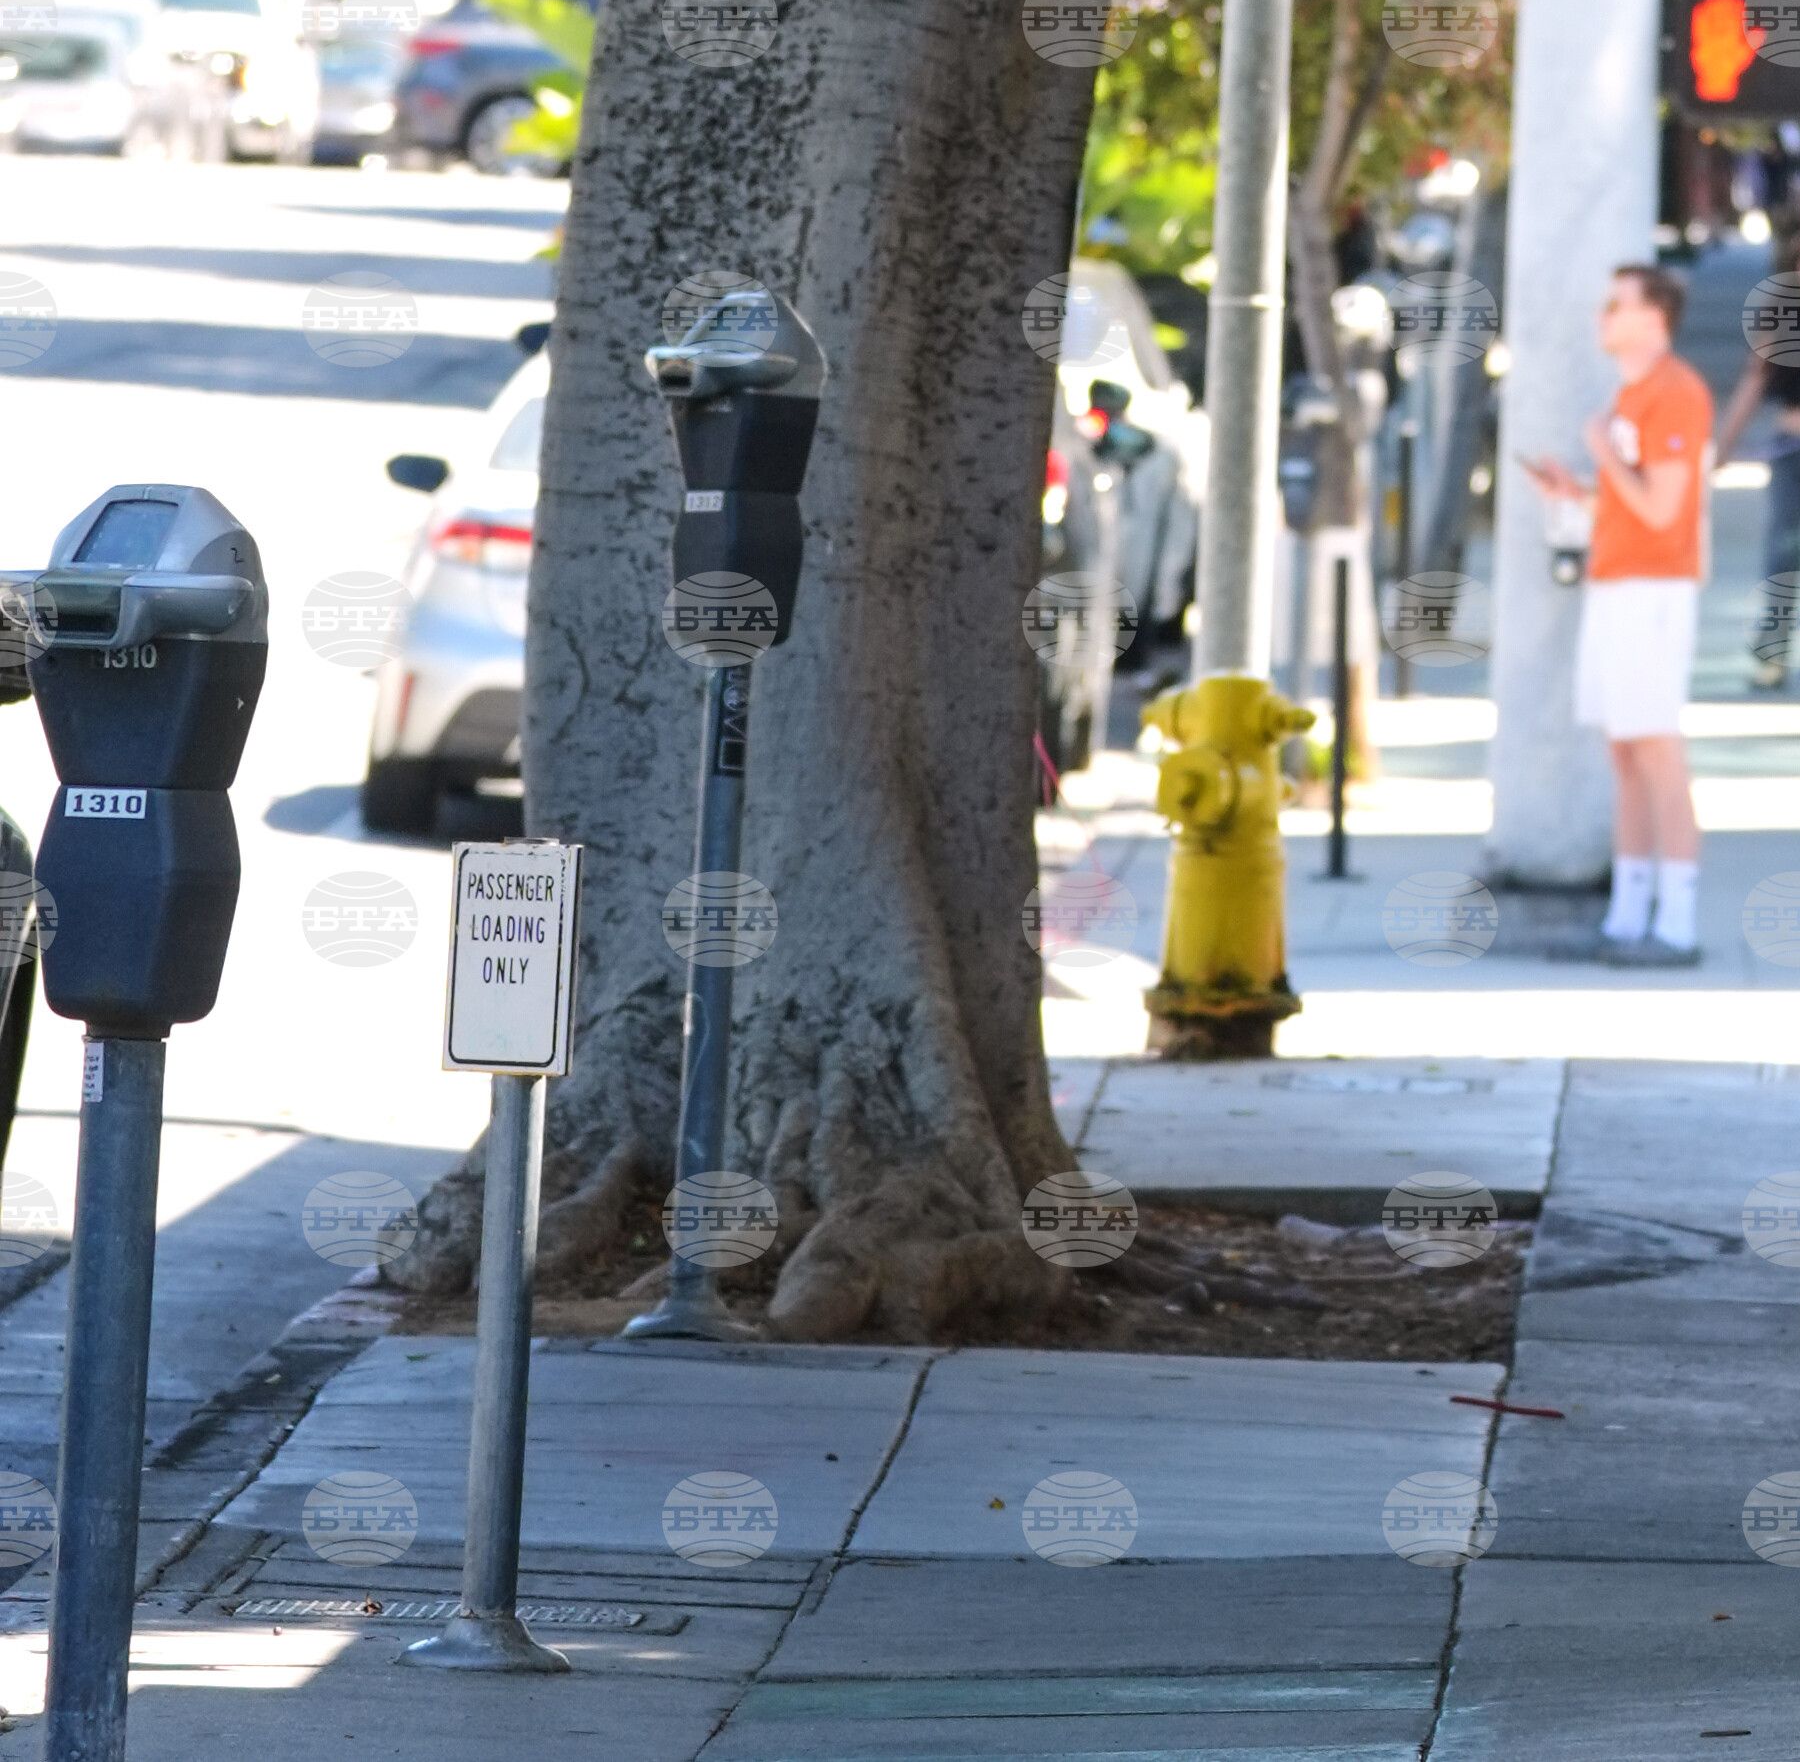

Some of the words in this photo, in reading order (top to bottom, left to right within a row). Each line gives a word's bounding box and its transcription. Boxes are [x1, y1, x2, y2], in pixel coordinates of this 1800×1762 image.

[102, 643, 158, 669] 1310
[72, 792, 143, 815] 1310
[467, 872, 554, 902] PASSENGER
[471, 914, 546, 944] LOADING
[483, 956, 530, 985] ONLY
